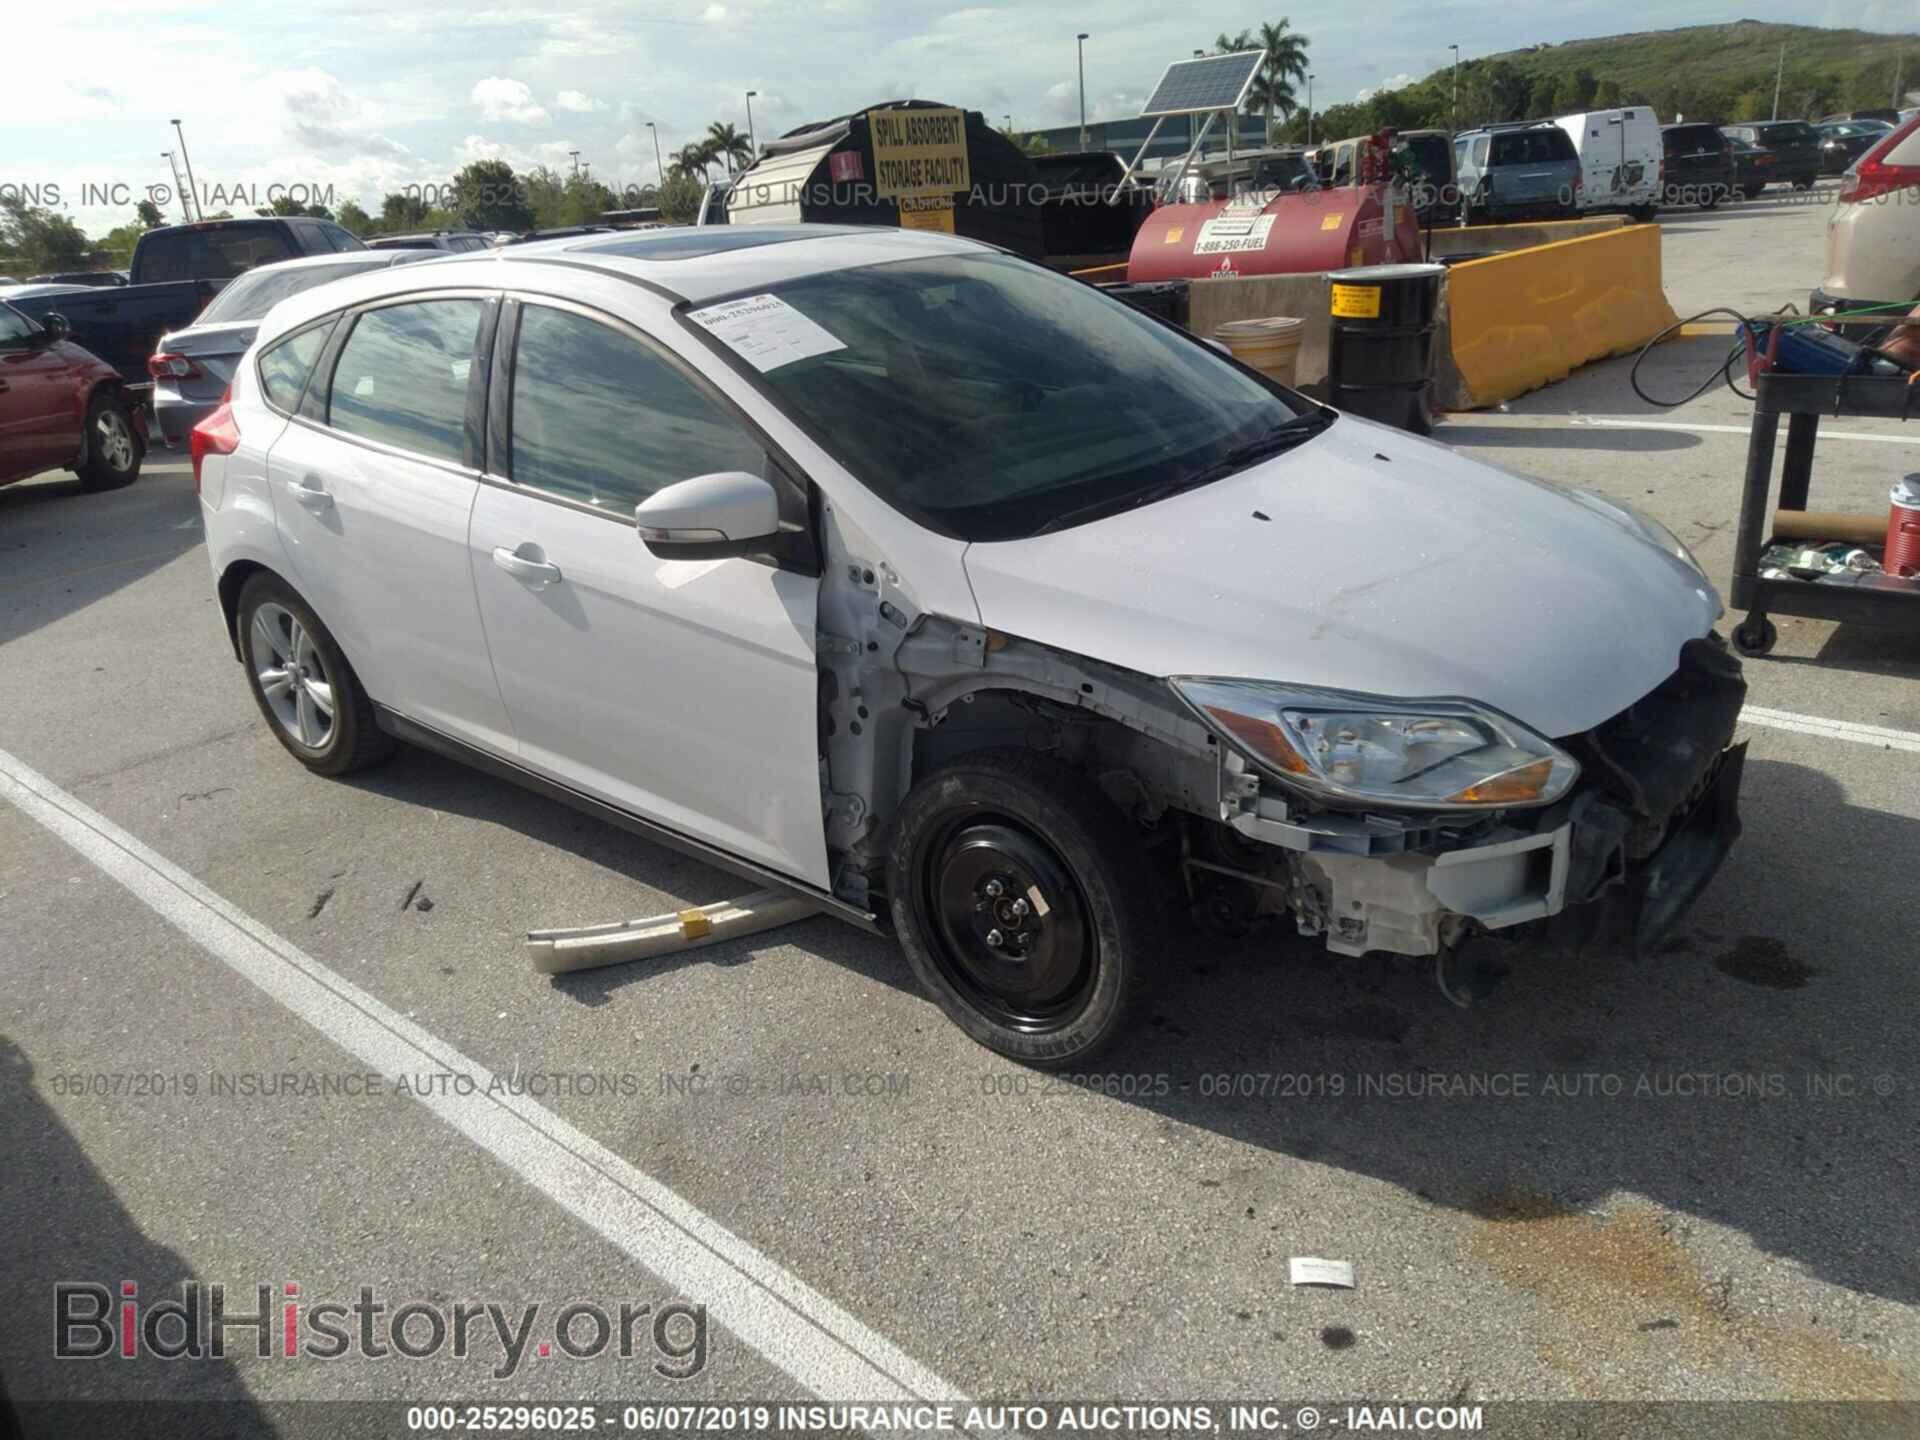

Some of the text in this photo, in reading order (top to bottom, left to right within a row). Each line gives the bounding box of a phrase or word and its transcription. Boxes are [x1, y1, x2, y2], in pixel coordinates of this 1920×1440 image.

[876, 115, 960, 147] SPILL ABSORBENT
[880, 156, 966, 189] STORAGE FACILITY
[902, 195, 953, 212] CAUTION
